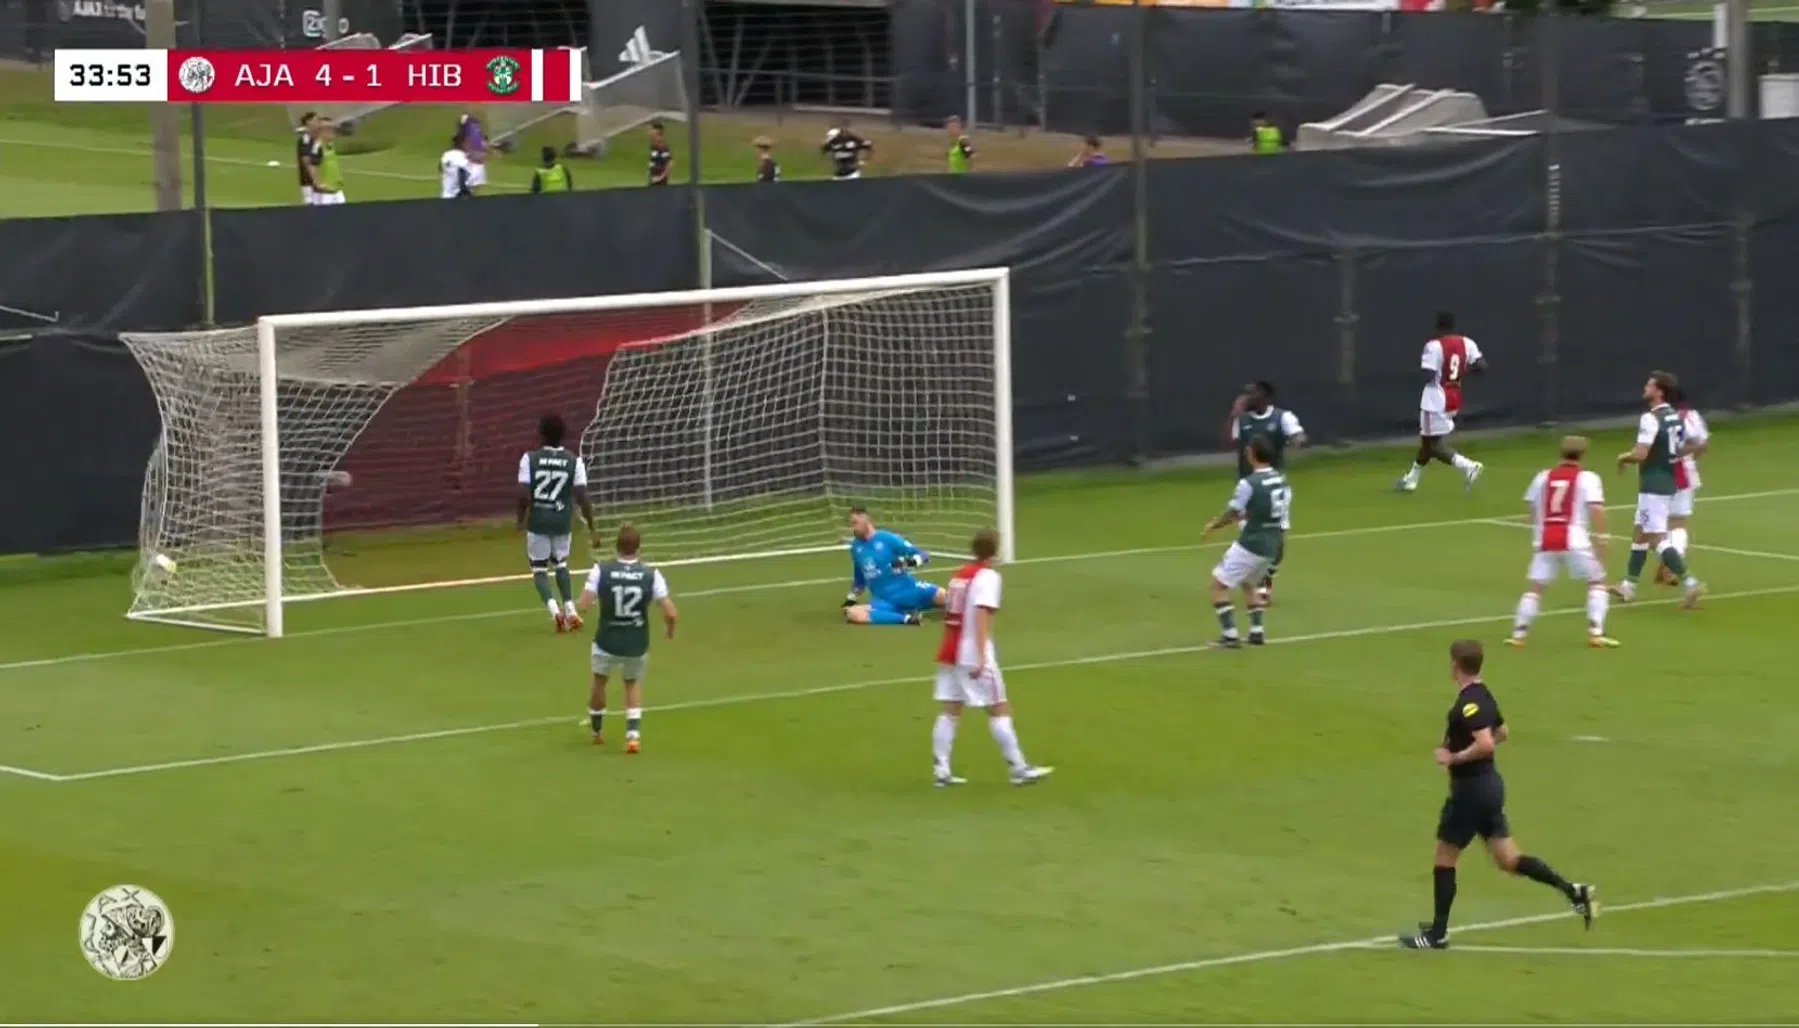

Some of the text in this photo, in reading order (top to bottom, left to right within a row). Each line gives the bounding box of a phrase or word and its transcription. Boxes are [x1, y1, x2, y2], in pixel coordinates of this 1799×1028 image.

[1450, 353, 1460, 380] 9
[534, 470, 569, 501] 27
[1550, 480, 1570, 513] 7
[611, 585, 643, 617] 12
